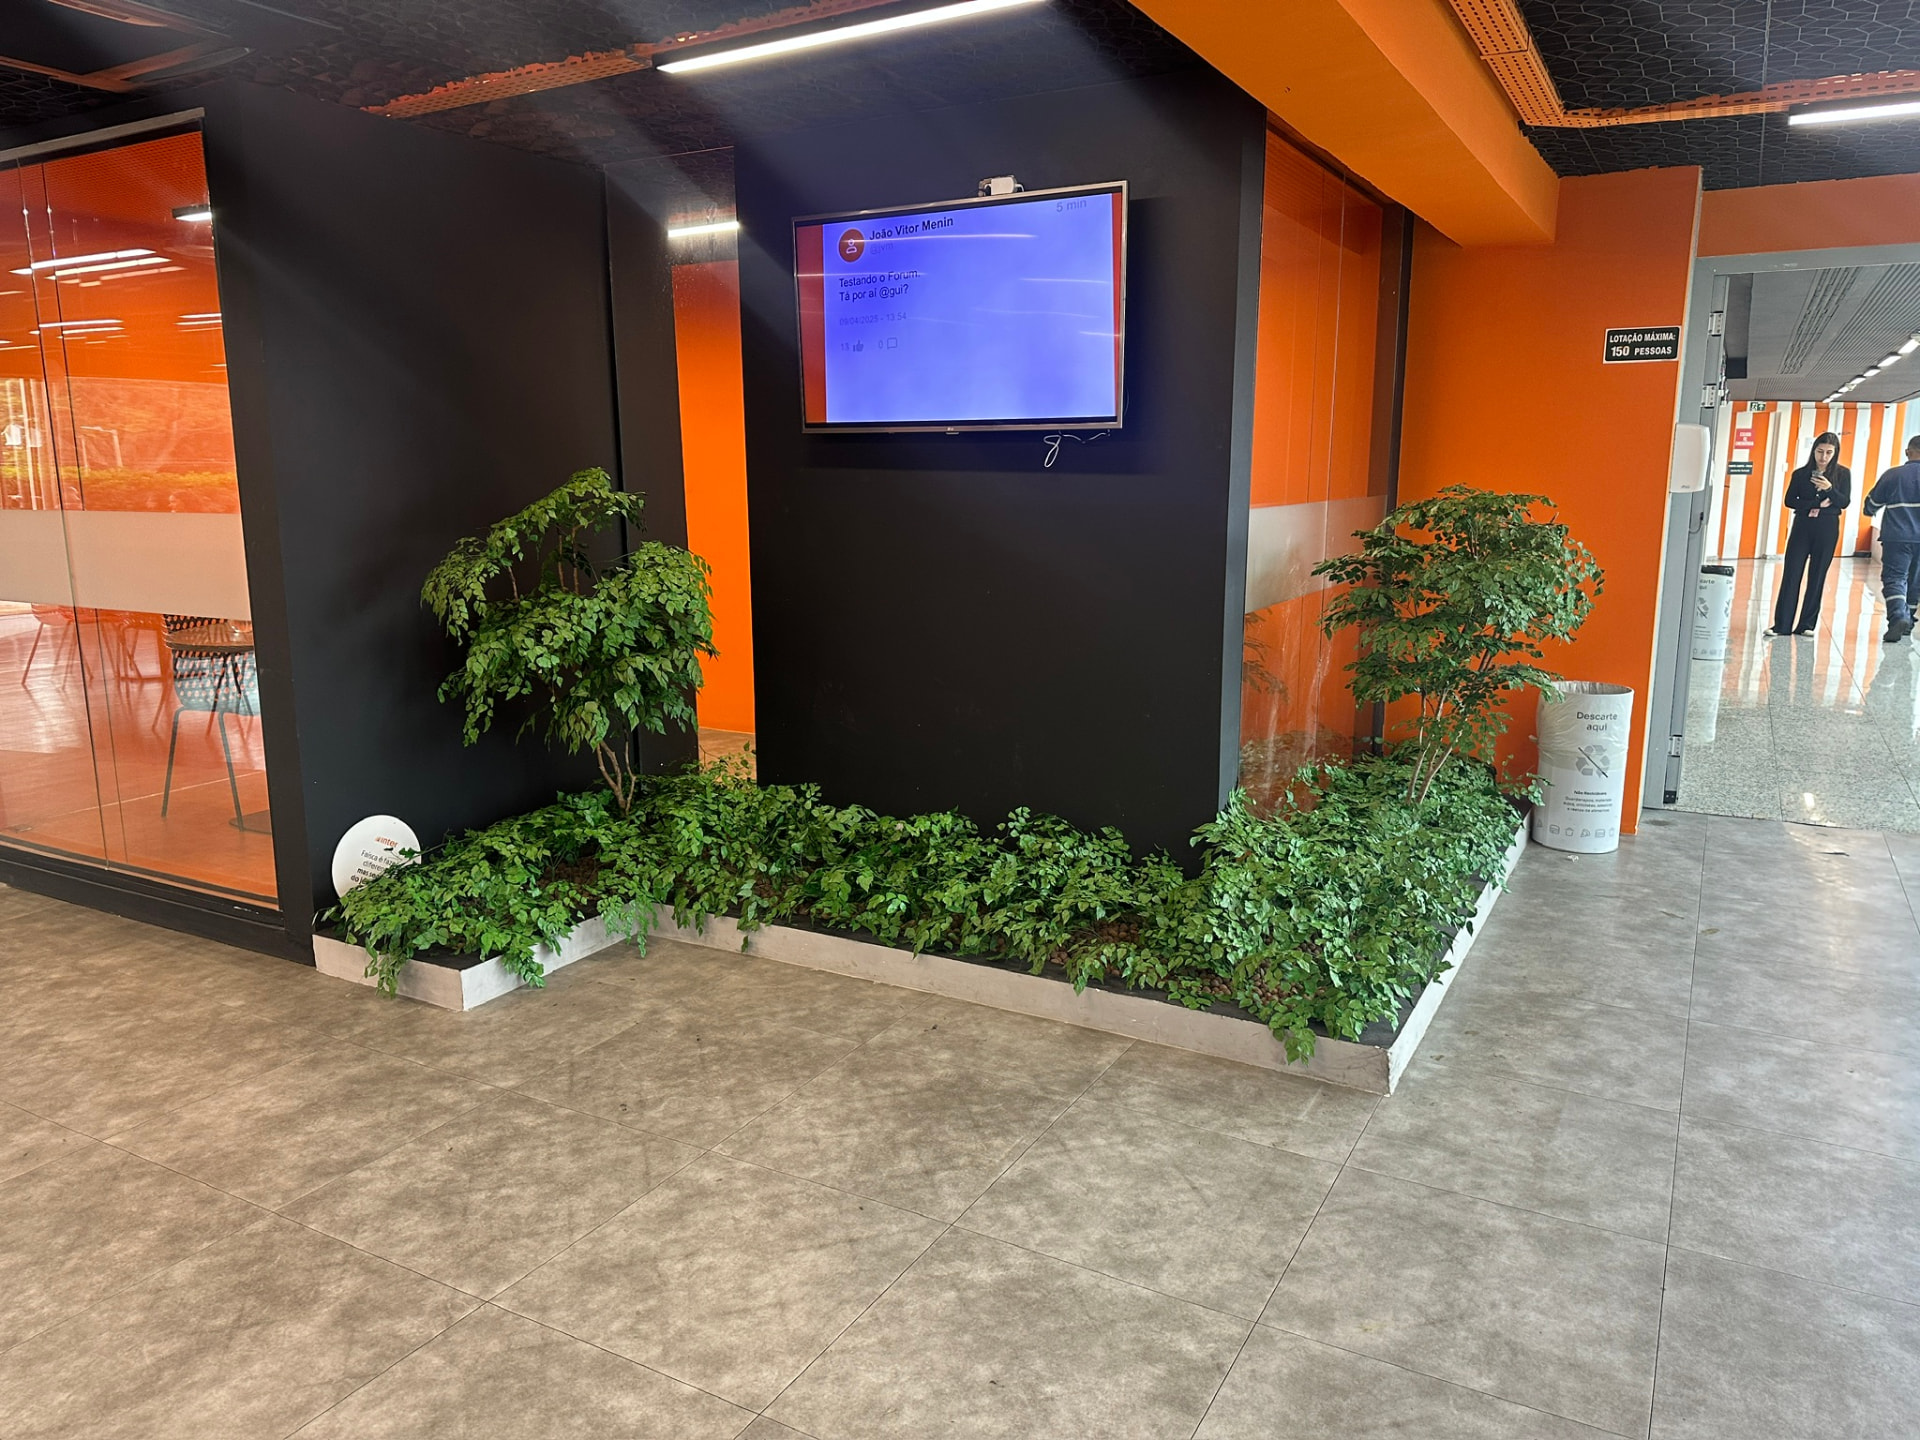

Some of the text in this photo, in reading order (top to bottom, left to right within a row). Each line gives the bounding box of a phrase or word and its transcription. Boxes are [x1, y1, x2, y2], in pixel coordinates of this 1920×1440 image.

[1056, 199, 1087, 213] 5 min
[869, 216, 954, 241] João Vitor Menin
[839, 274, 878, 288] Testando
[879, 275, 886, 283] o
[852, 291, 867, 303] por
[879, 283, 909, 299] @gui?
[1609, 331, 1676, 344] LOTAÇÃO MÁXIMA:
[1611, 345, 1672, 357] 150 PESSOAS
[1577, 711, 1617, 720] Descarte
[1587, 723, 1607, 732] aqui
